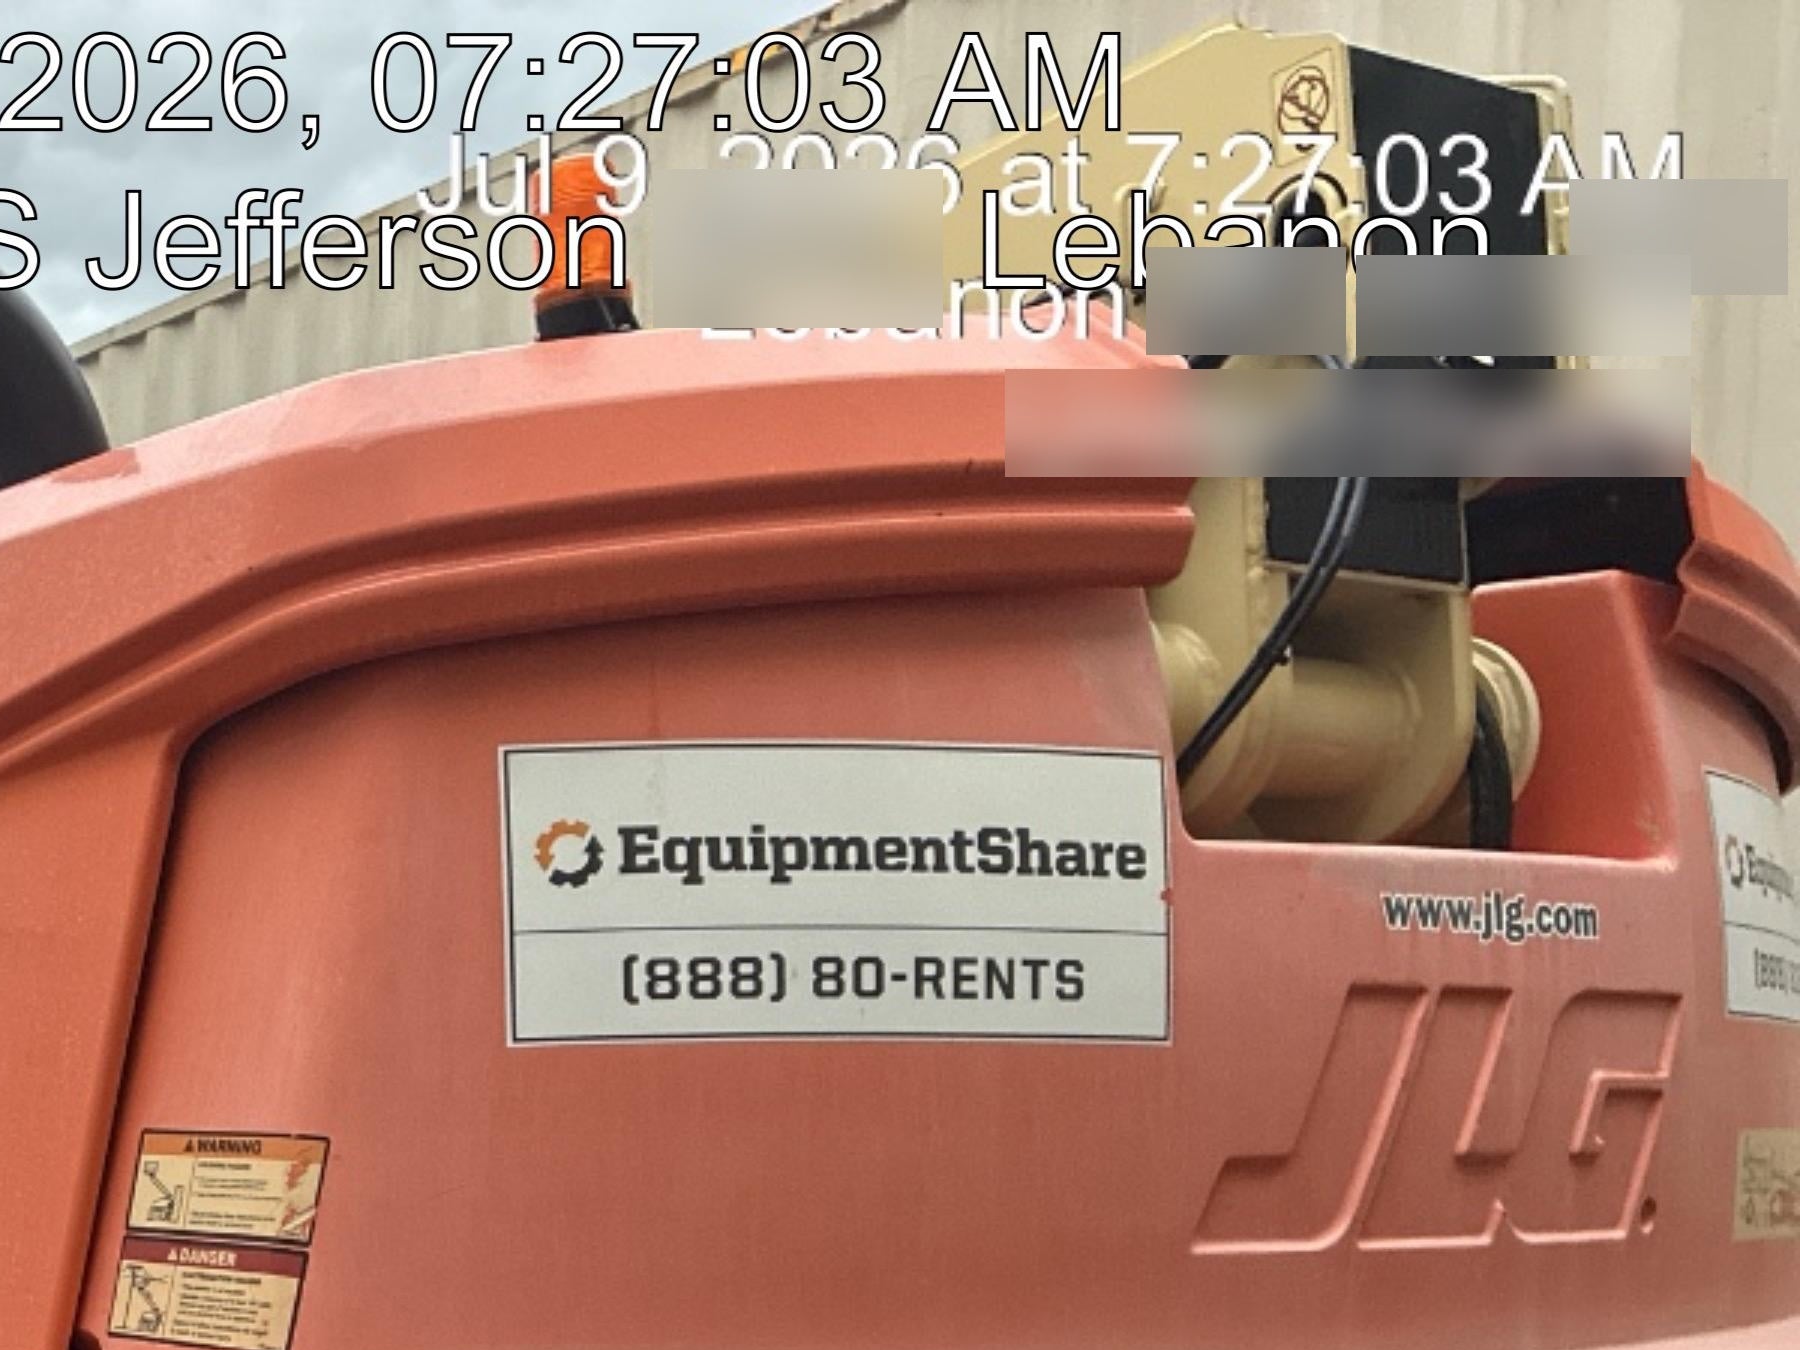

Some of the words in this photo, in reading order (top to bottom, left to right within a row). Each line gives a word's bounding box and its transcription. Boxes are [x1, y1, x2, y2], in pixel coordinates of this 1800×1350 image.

[617, 824, 1147, 886] EquipmentShare
[1382, 892, 1599, 943] www.jlg.com
[622, 953, 788, 1005] (888)
[812, 955, 1086, 1002] 80-RENTS
[1190, 980, 1684, 1255] JLG
